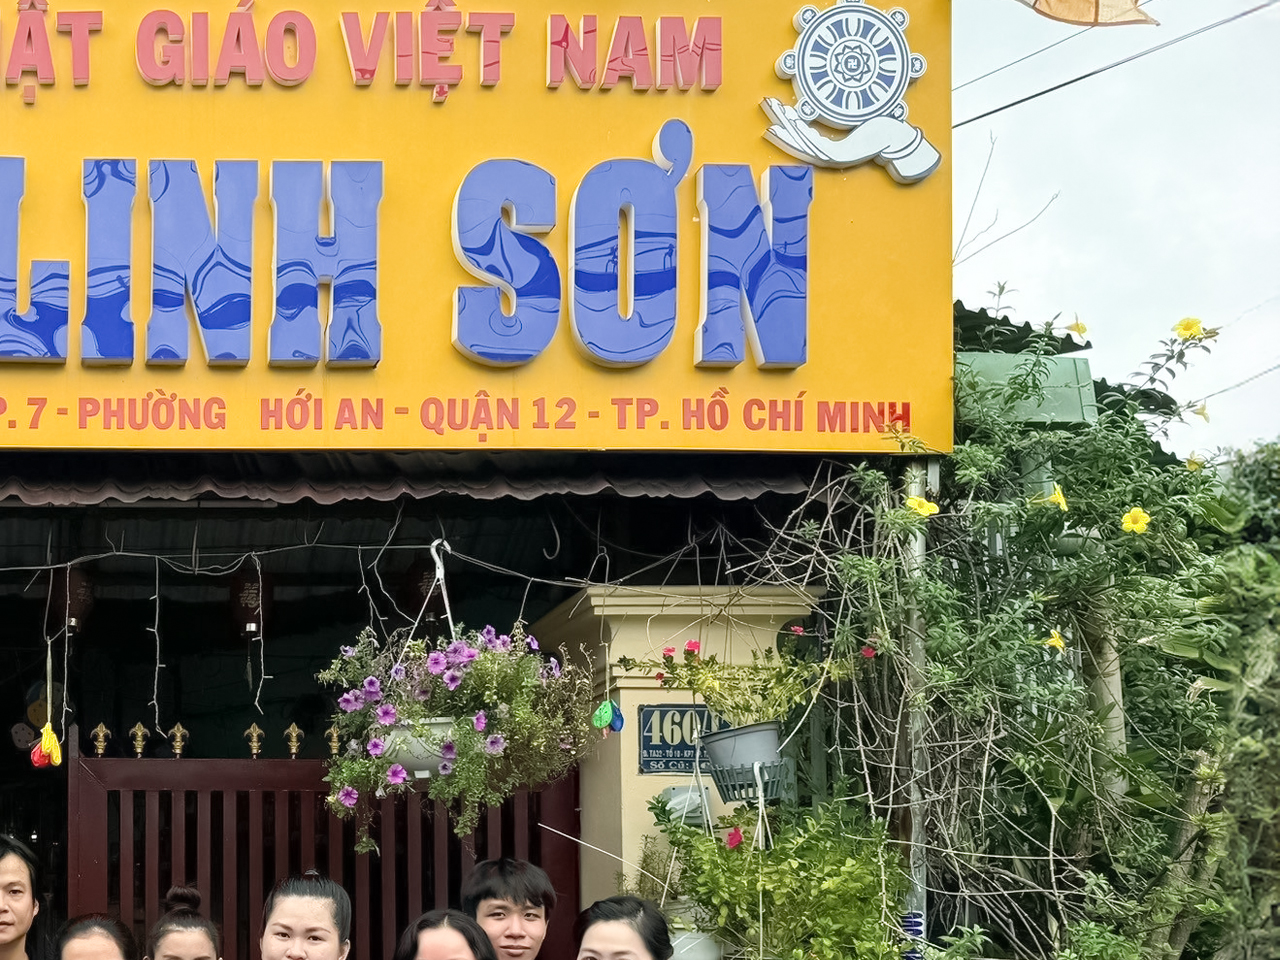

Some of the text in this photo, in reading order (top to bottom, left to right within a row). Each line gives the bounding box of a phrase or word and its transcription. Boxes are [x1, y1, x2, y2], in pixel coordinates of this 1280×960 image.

[135, 0, 317, 86] GIÁO
[339, 0, 515, 102] VIỆT
[546, 14, 722, 90] NAM
[451, 118, 814, 369] SƠN
[26, 396, 48, 430] 7
[78, 388, 227, 431] PHƯỜNG
[260, 388, 323, 431] HỚI
[334, 397, 384, 431] AN
[420, 389, 520, 442] QUẬN
[531, 397, 577, 430] 12
[611, 397, 670, 431] TP.
[681, 386, 729, 431] HỒ
[743, 390, 807, 432] CHÍ
[817, 400, 911, 434] MINH
